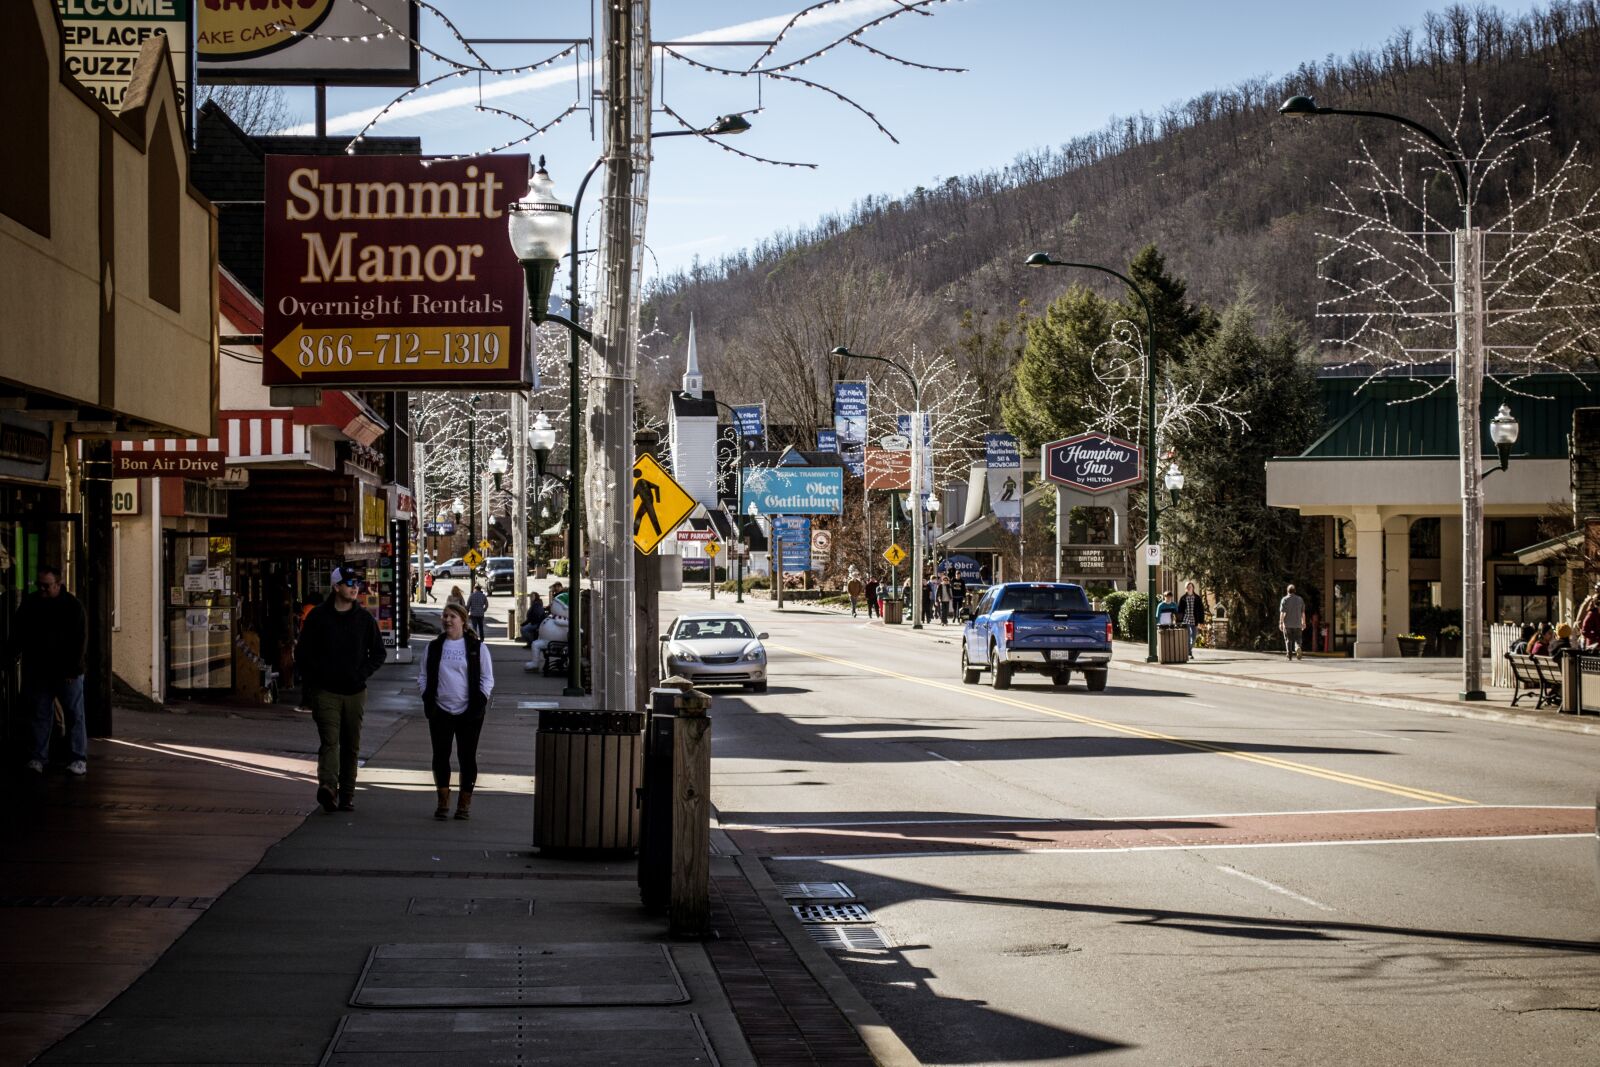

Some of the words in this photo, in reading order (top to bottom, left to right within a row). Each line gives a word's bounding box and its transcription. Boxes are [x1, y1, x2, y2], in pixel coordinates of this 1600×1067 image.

[286, 165, 503, 221] Summit
[300, 232, 484, 284] Manor
[278, 295, 401, 321] Overnight
[410, 293, 504, 314] Rentals
[298, 332, 500, 367] 866-712-1319
[121, 457, 148, 470] Bon
[152, 457, 176, 470] Air
[180, 457, 219, 470] Drive
[1060, 446, 1131, 463] Hampton
[1075, 460, 1114, 476] Inn
[806, 481, 840, 496] Ober
[112, 491, 133, 511] CO
[764, 494, 840, 512] Gatlinburg
[954, 561, 974, 569] Ober
